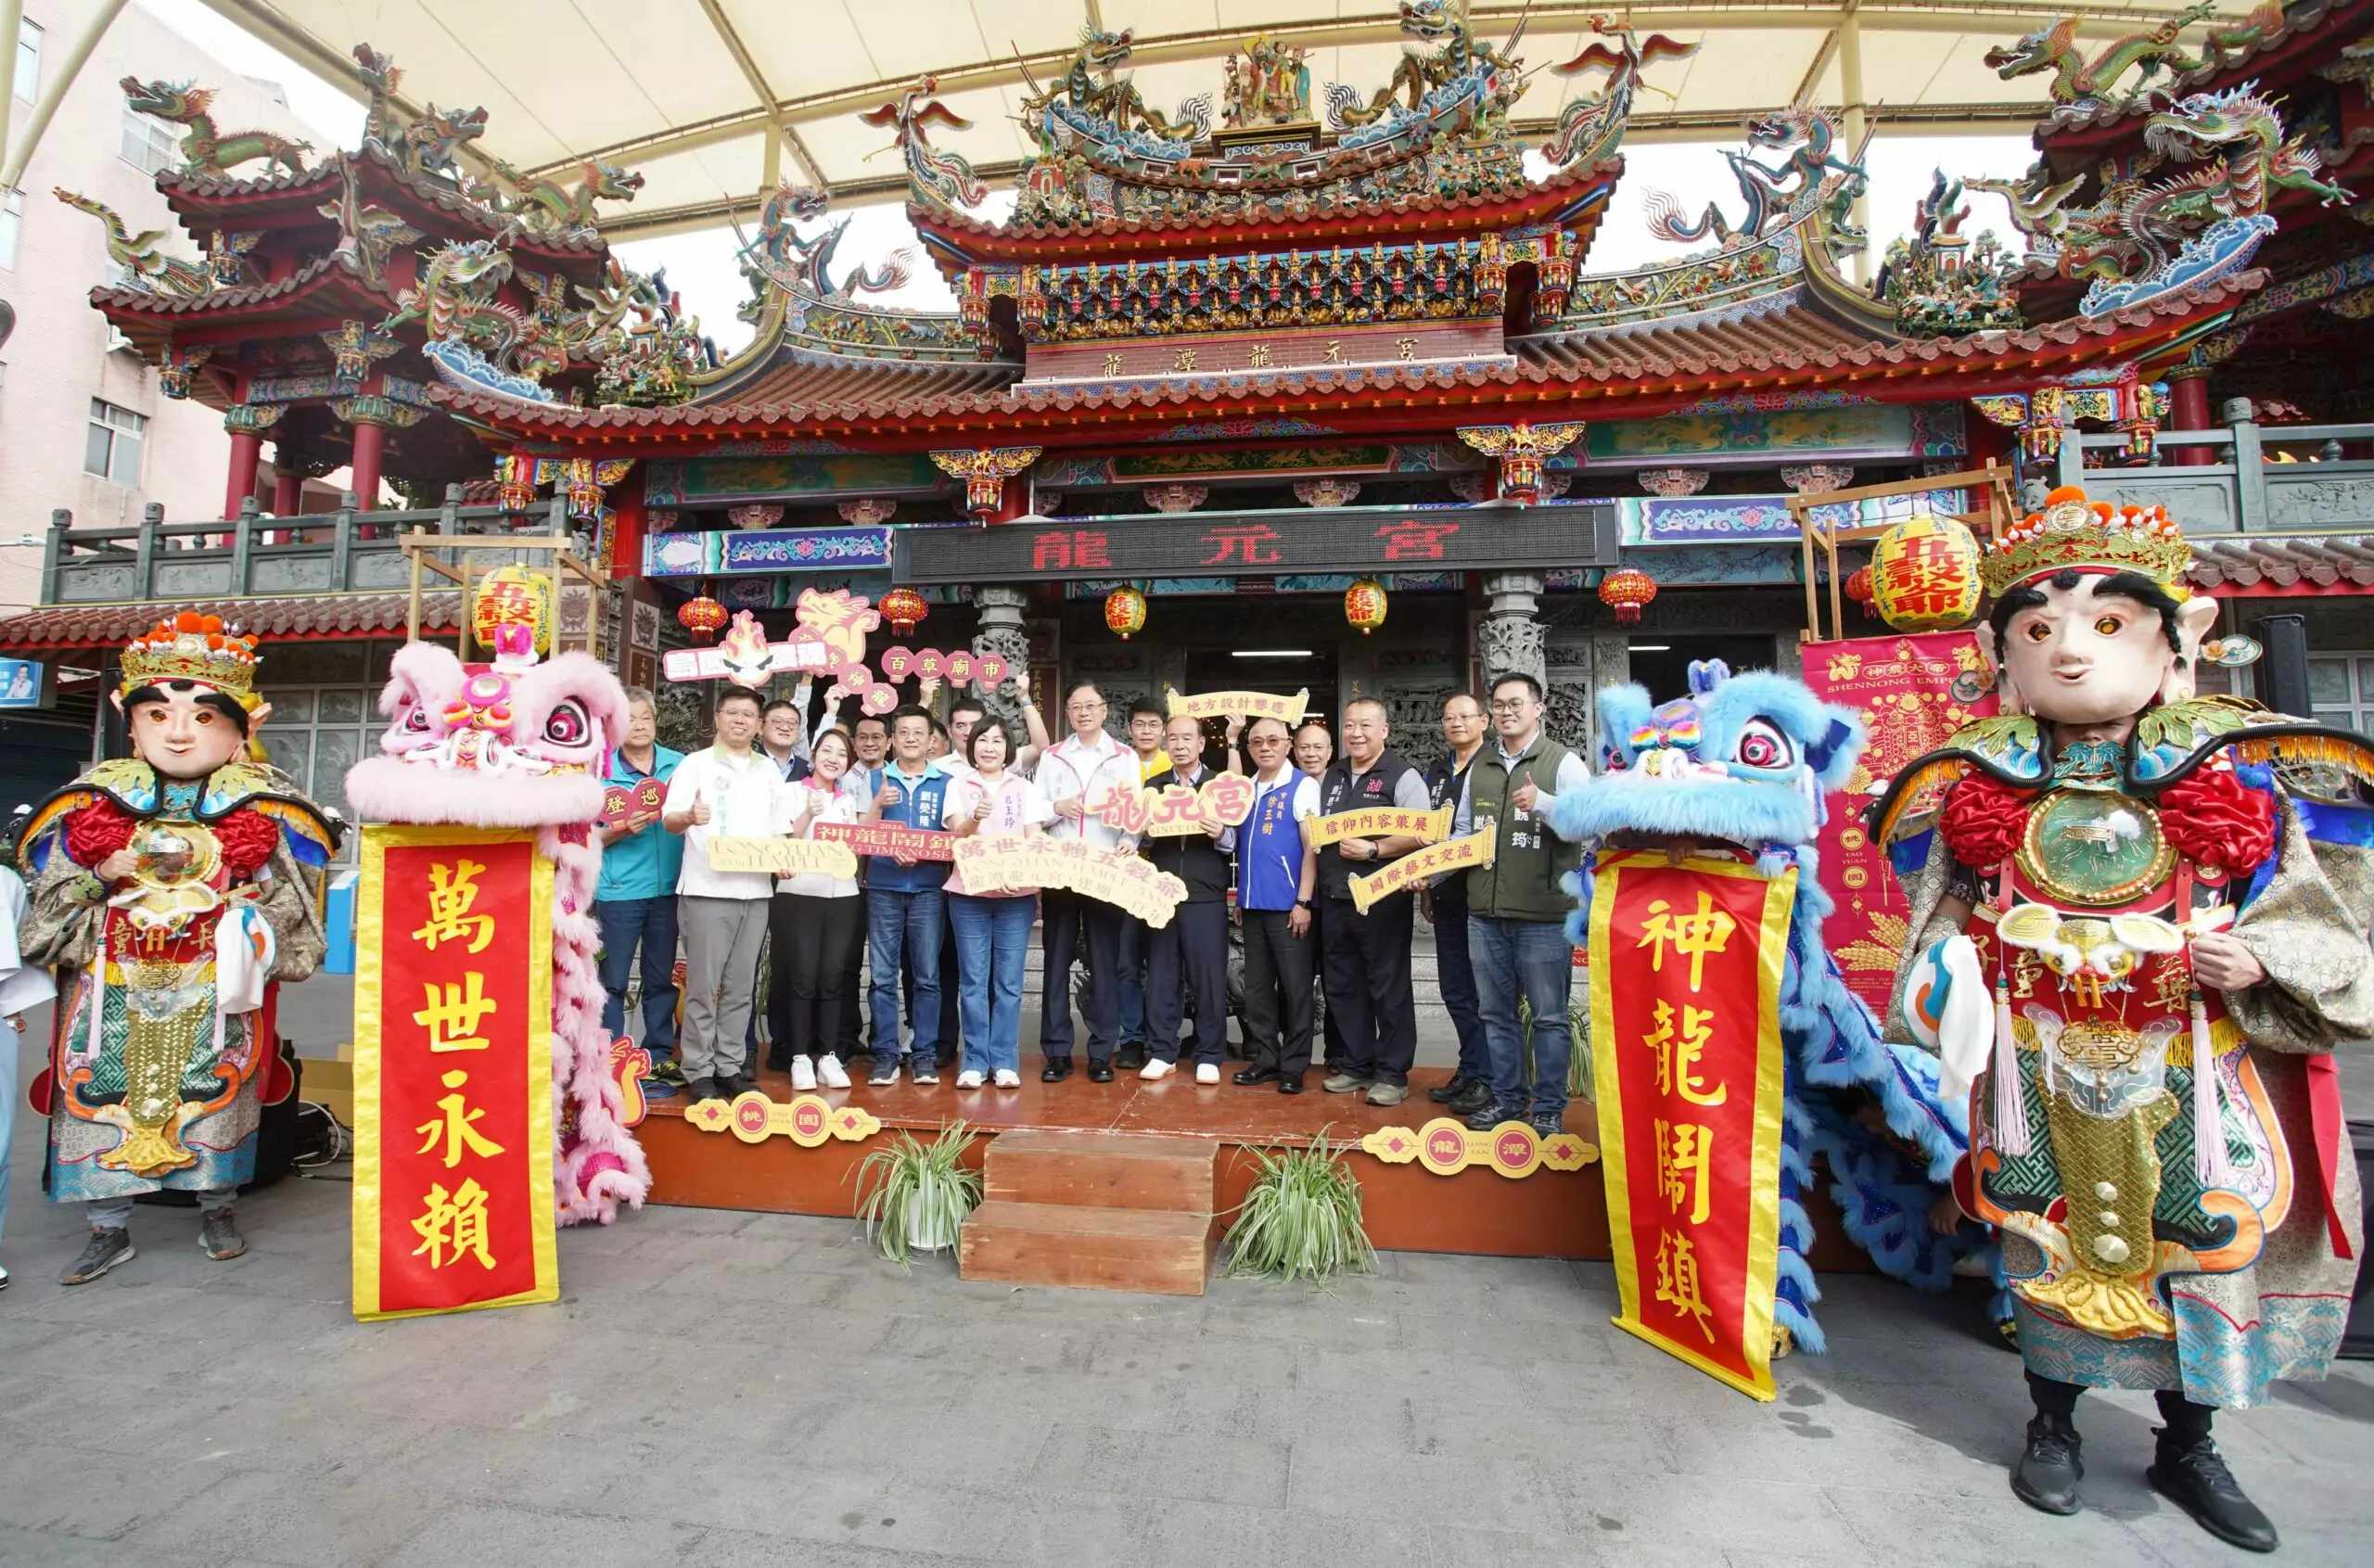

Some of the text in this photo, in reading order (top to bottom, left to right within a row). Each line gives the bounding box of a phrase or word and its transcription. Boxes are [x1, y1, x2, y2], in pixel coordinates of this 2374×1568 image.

[1102, 337, 1419, 376] 龍潭龍元宮
[1033, 519, 1460, 570] 龍元宮
[890, 656, 1000, 678] 百草廟市
[1866, 662, 1946, 677] 神農大帝
[1827, 678, 1910, 694] SHENNONG
[606, 786, 661, 815] 登巡
[1091, 775, 1252, 831] 龍元宮
[1151, 823, 1183, 834] SINCE
[1324, 812, 1429, 835] 信仰內容策展
[715, 840, 844, 858] LONGYUAN
[817, 825, 958, 851] 神龍鬧鎮
[867, 845, 900, 855] TIME
[908, 848, 930, 858] NO
[958, 836, 1182, 900] 萬世永賴五穀爺
[1369, 843, 1474, 895] 國際藝文交流
[411, 859, 505, 1270] 萬世永賴
[741, 1110, 763, 1123] 桃
[798, 1114, 819, 1127] 園
[1635, 889, 1737, 1345] 神龍鬧鎮
[1431, 1140, 1460, 1154] 龍
[1502, 1142, 1528, 1157] 潭
